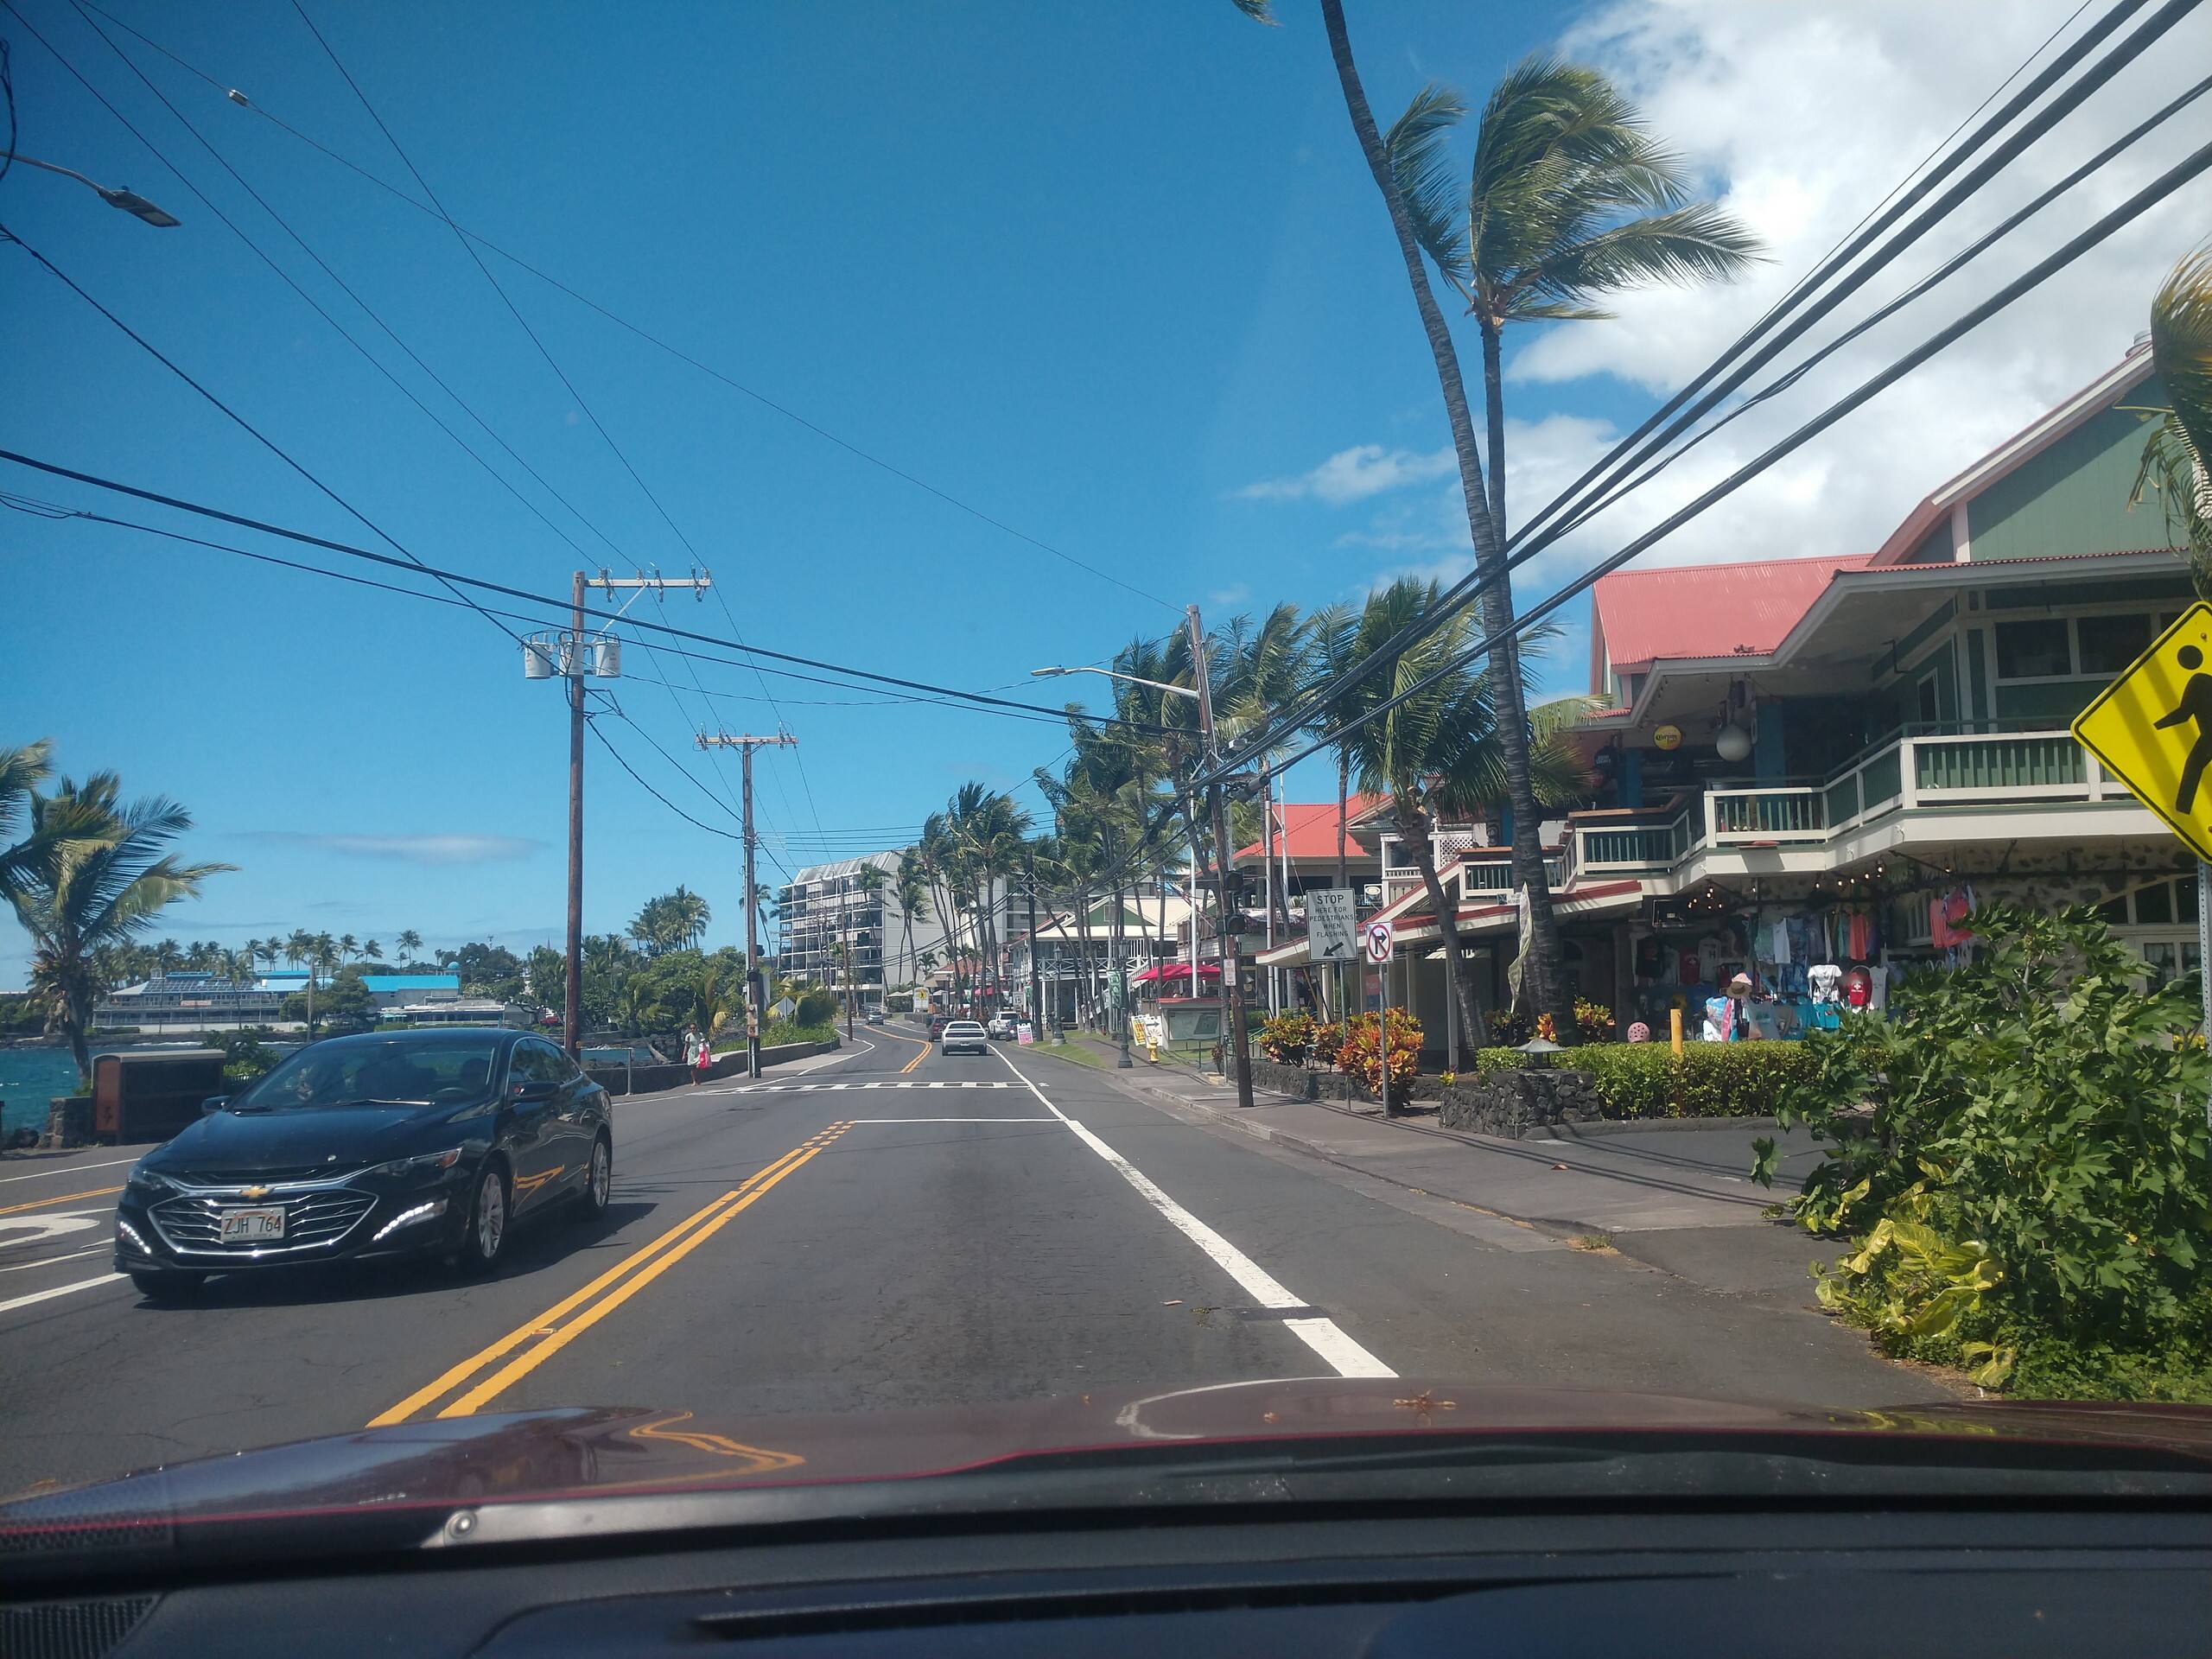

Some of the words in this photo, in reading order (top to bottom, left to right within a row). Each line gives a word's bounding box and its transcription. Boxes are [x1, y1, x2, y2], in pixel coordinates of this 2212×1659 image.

[1317, 894, 1344, 905] STOP
[224, 1217, 250, 1235] ZJH
[257, 1214, 282, 1233] 764
